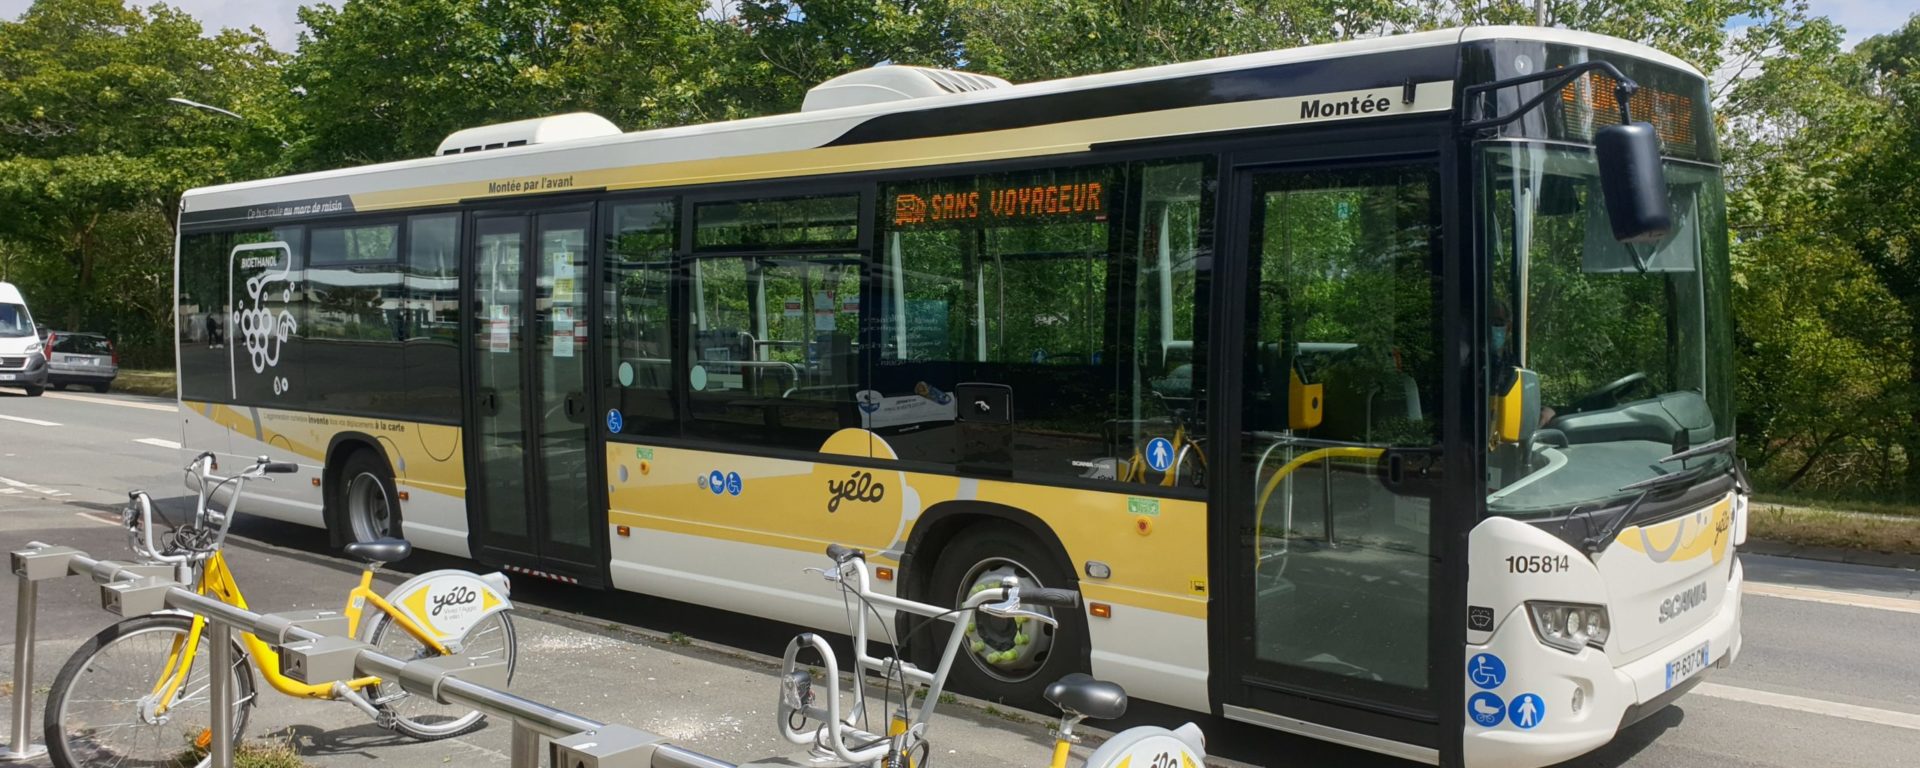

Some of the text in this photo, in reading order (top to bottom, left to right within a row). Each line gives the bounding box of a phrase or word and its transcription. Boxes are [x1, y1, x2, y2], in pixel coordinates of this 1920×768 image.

[1300, 94, 1390, 119] Montée
[488, 175, 573, 193] Montée par l'avant
[283, 207, 293, 216] au
[293, 205, 311, 215] marc
[312, 202, 321, 213] de
[321, 200, 343, 212] raisin
[931, 182, 1102, 221] SANS VOYAGEUR
[241, 256, 278, 268] BIOETHANOL
[308, 416, 329, 425] invente
[380, 421, 387, 430] la
[387, 422, 405, 432] carte
[827, 470, 884, 513] yélo
[1505, 555, 1569, 573] 105814
[432, 586, 476, 616] yélo
[1658, 581, 1707, 624] SCANIA
